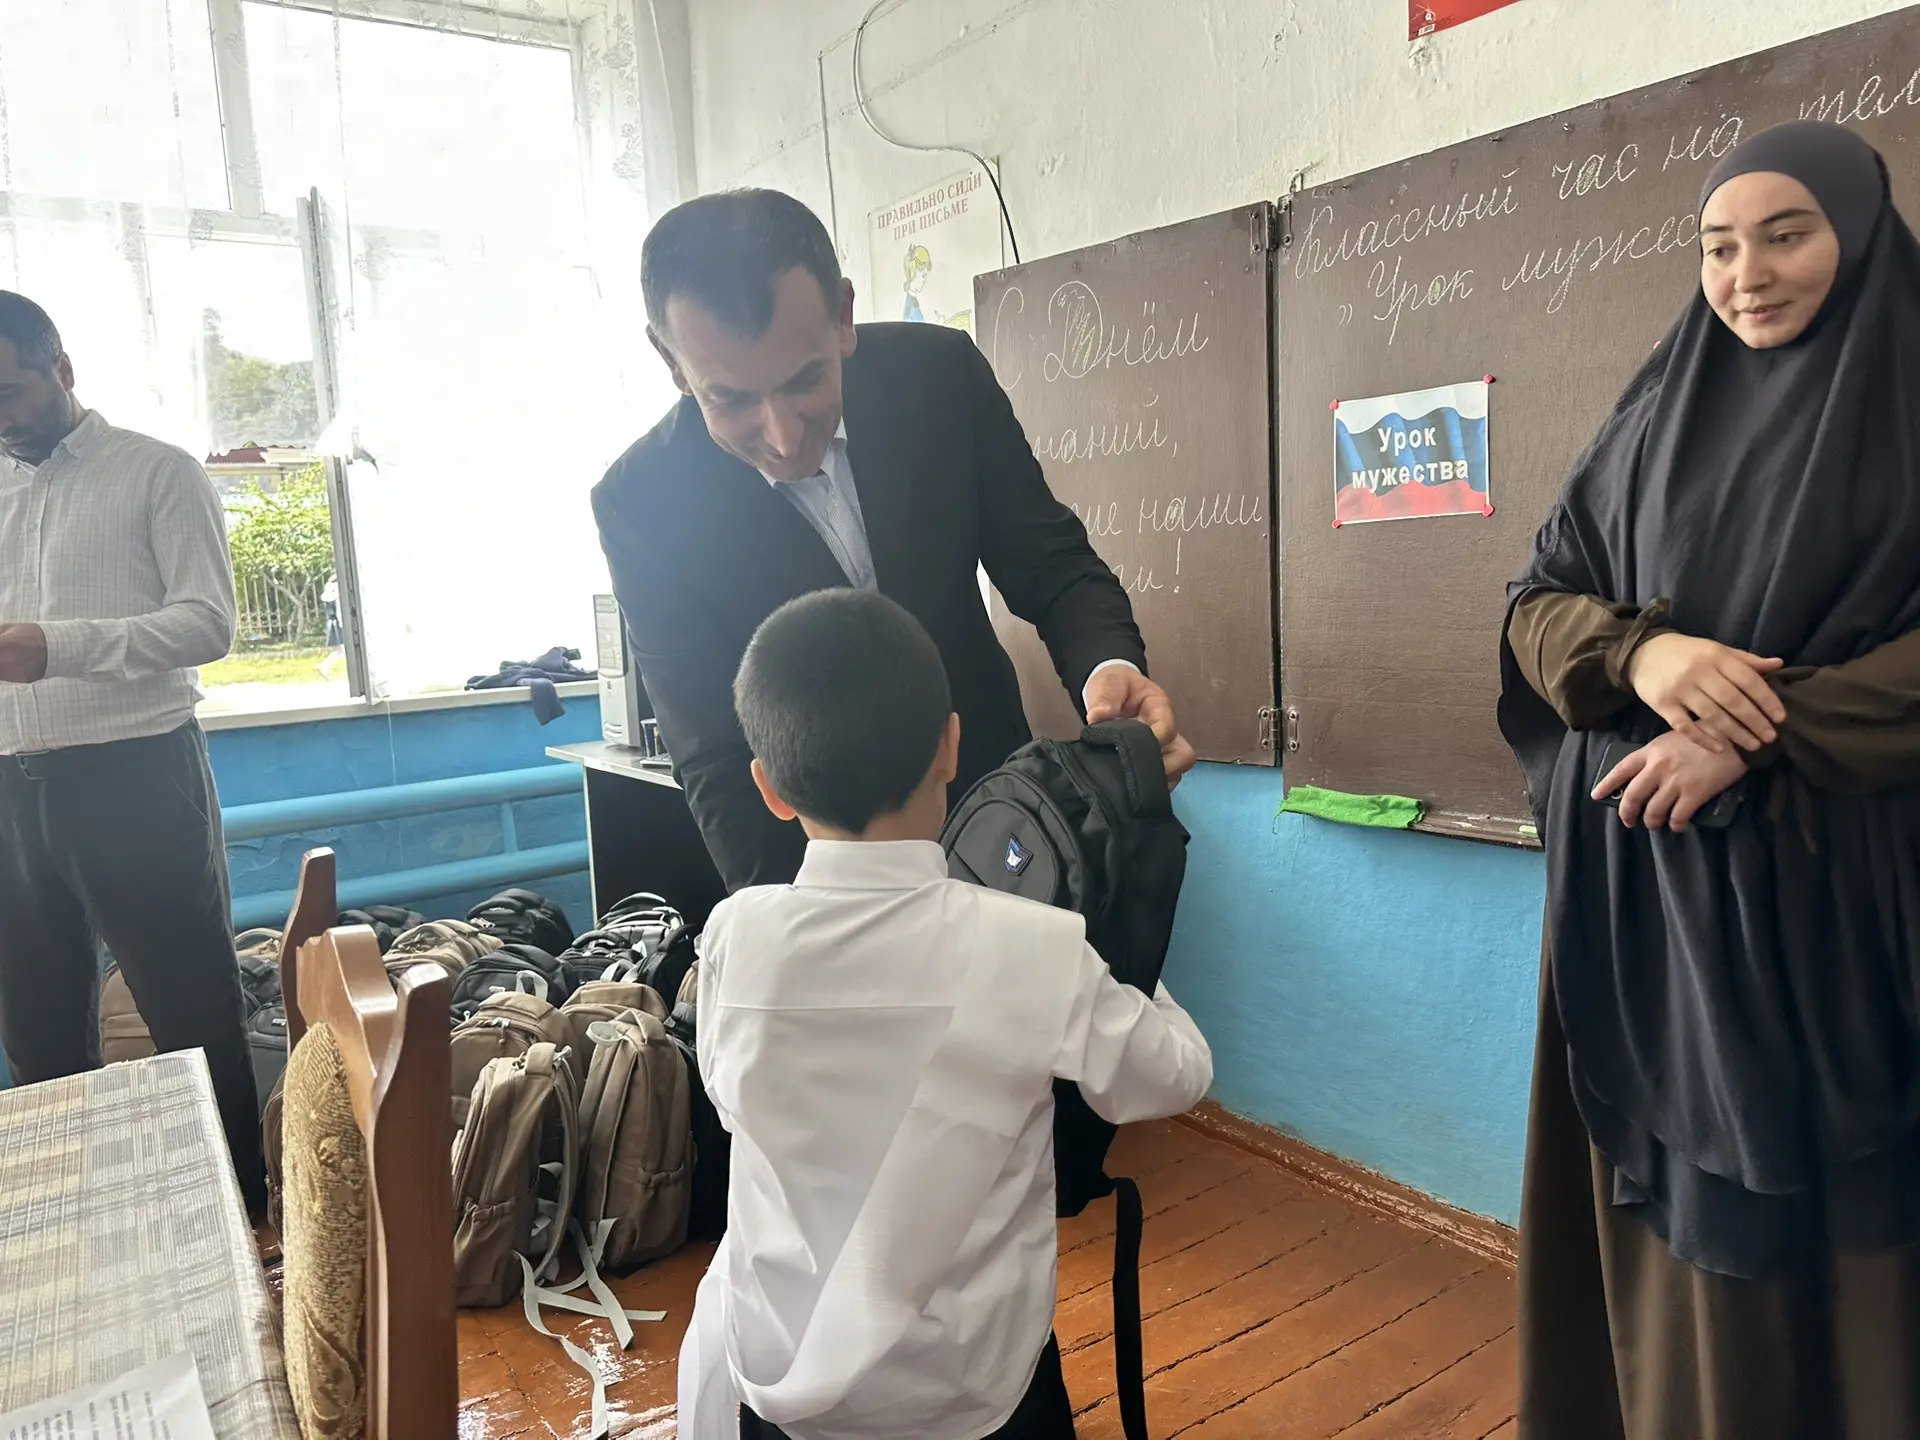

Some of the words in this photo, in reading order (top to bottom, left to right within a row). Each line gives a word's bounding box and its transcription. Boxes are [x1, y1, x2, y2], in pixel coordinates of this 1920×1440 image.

[877, 188, 945, 230] ПРАВИЛЬНО
[947, 171, 983, 199] СИДИ
[893, 219, 917, 241] ПРИ
[919, 198, 970, 230] ПИСЬМЕ
[1294, 167, 1520, 280] Классный
[1551, 143, 1639, 200] час
[1661, 116, 1744, 173] на
[1502, 214, 1699, 314] мужес
[993, 286, 1025, 390] С
[1043, 280, 1209, 383] Днём
[1032, 394, 1178, 464] наний,
[1377, 426, 1437, 457] Урок
[1351, 459, 1469, 494] мужества
[1138, 493, 1263, 533] наши
